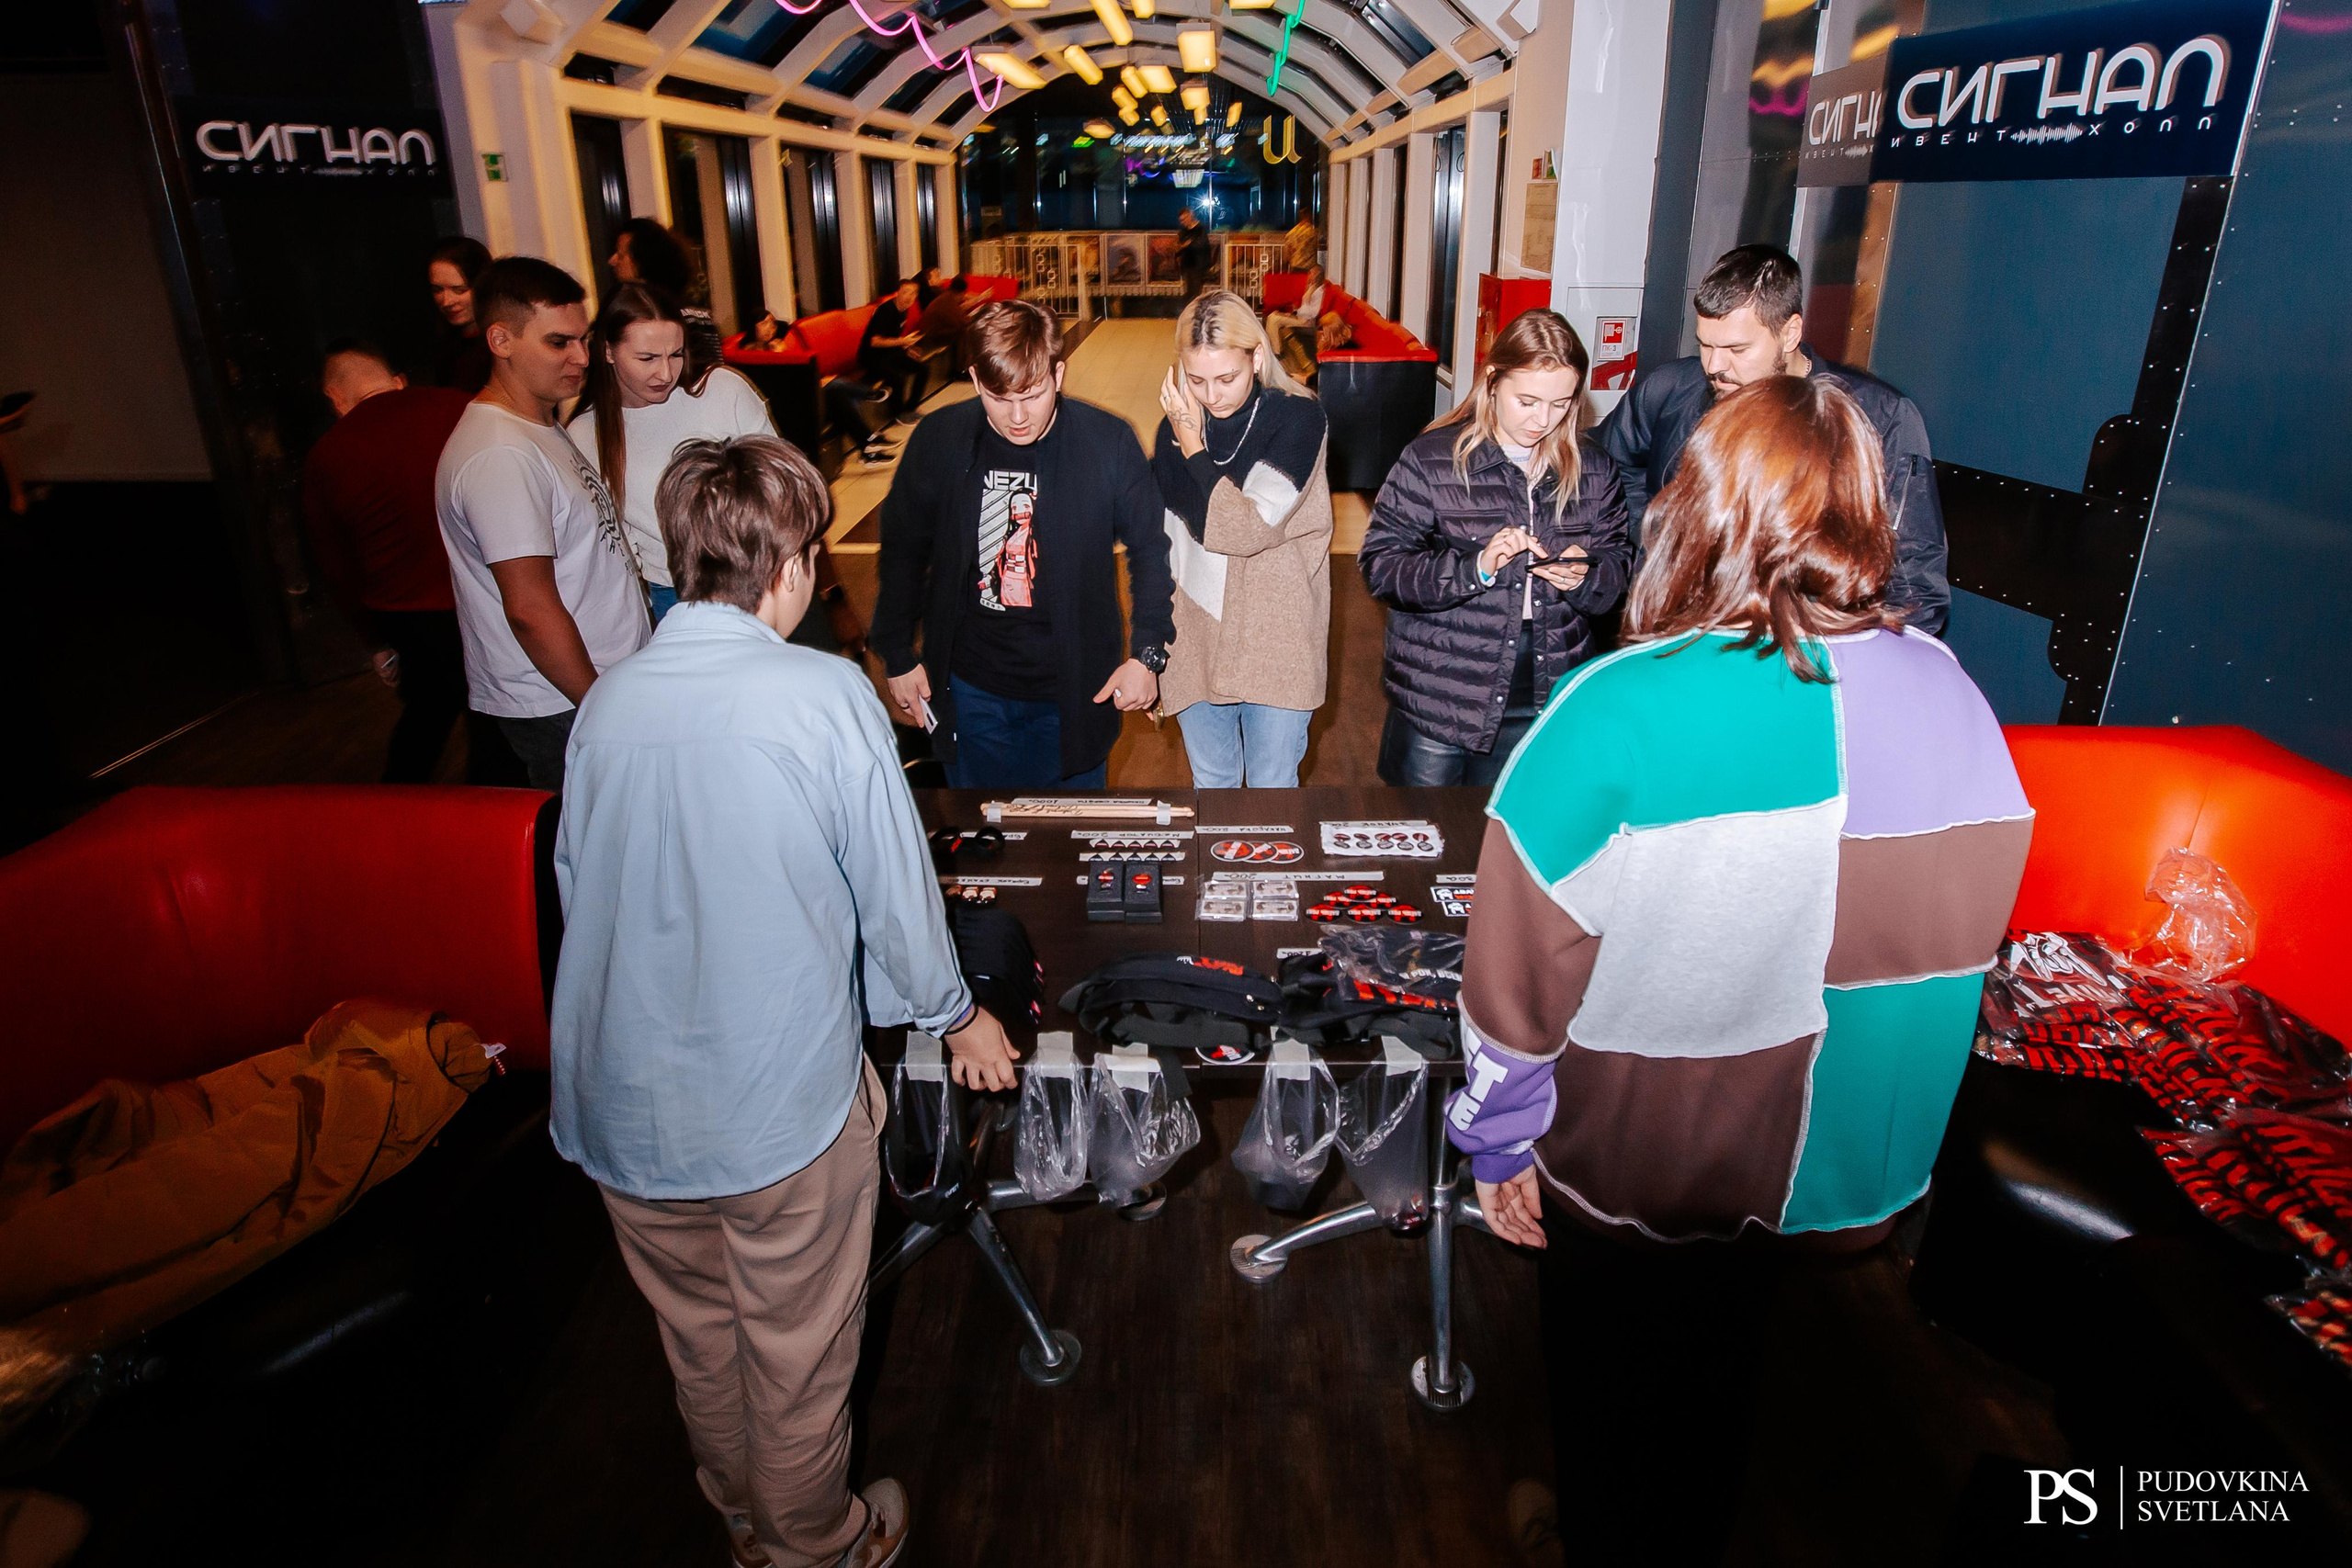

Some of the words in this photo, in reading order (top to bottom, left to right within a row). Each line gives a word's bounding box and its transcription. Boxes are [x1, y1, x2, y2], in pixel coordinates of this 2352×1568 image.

[1898, 39, 2225, 129] СИГНАЛ
[197, 122, 433, 165] СИГНАЛ
[1891, 130, 2007, 147] ИВЕНТ
